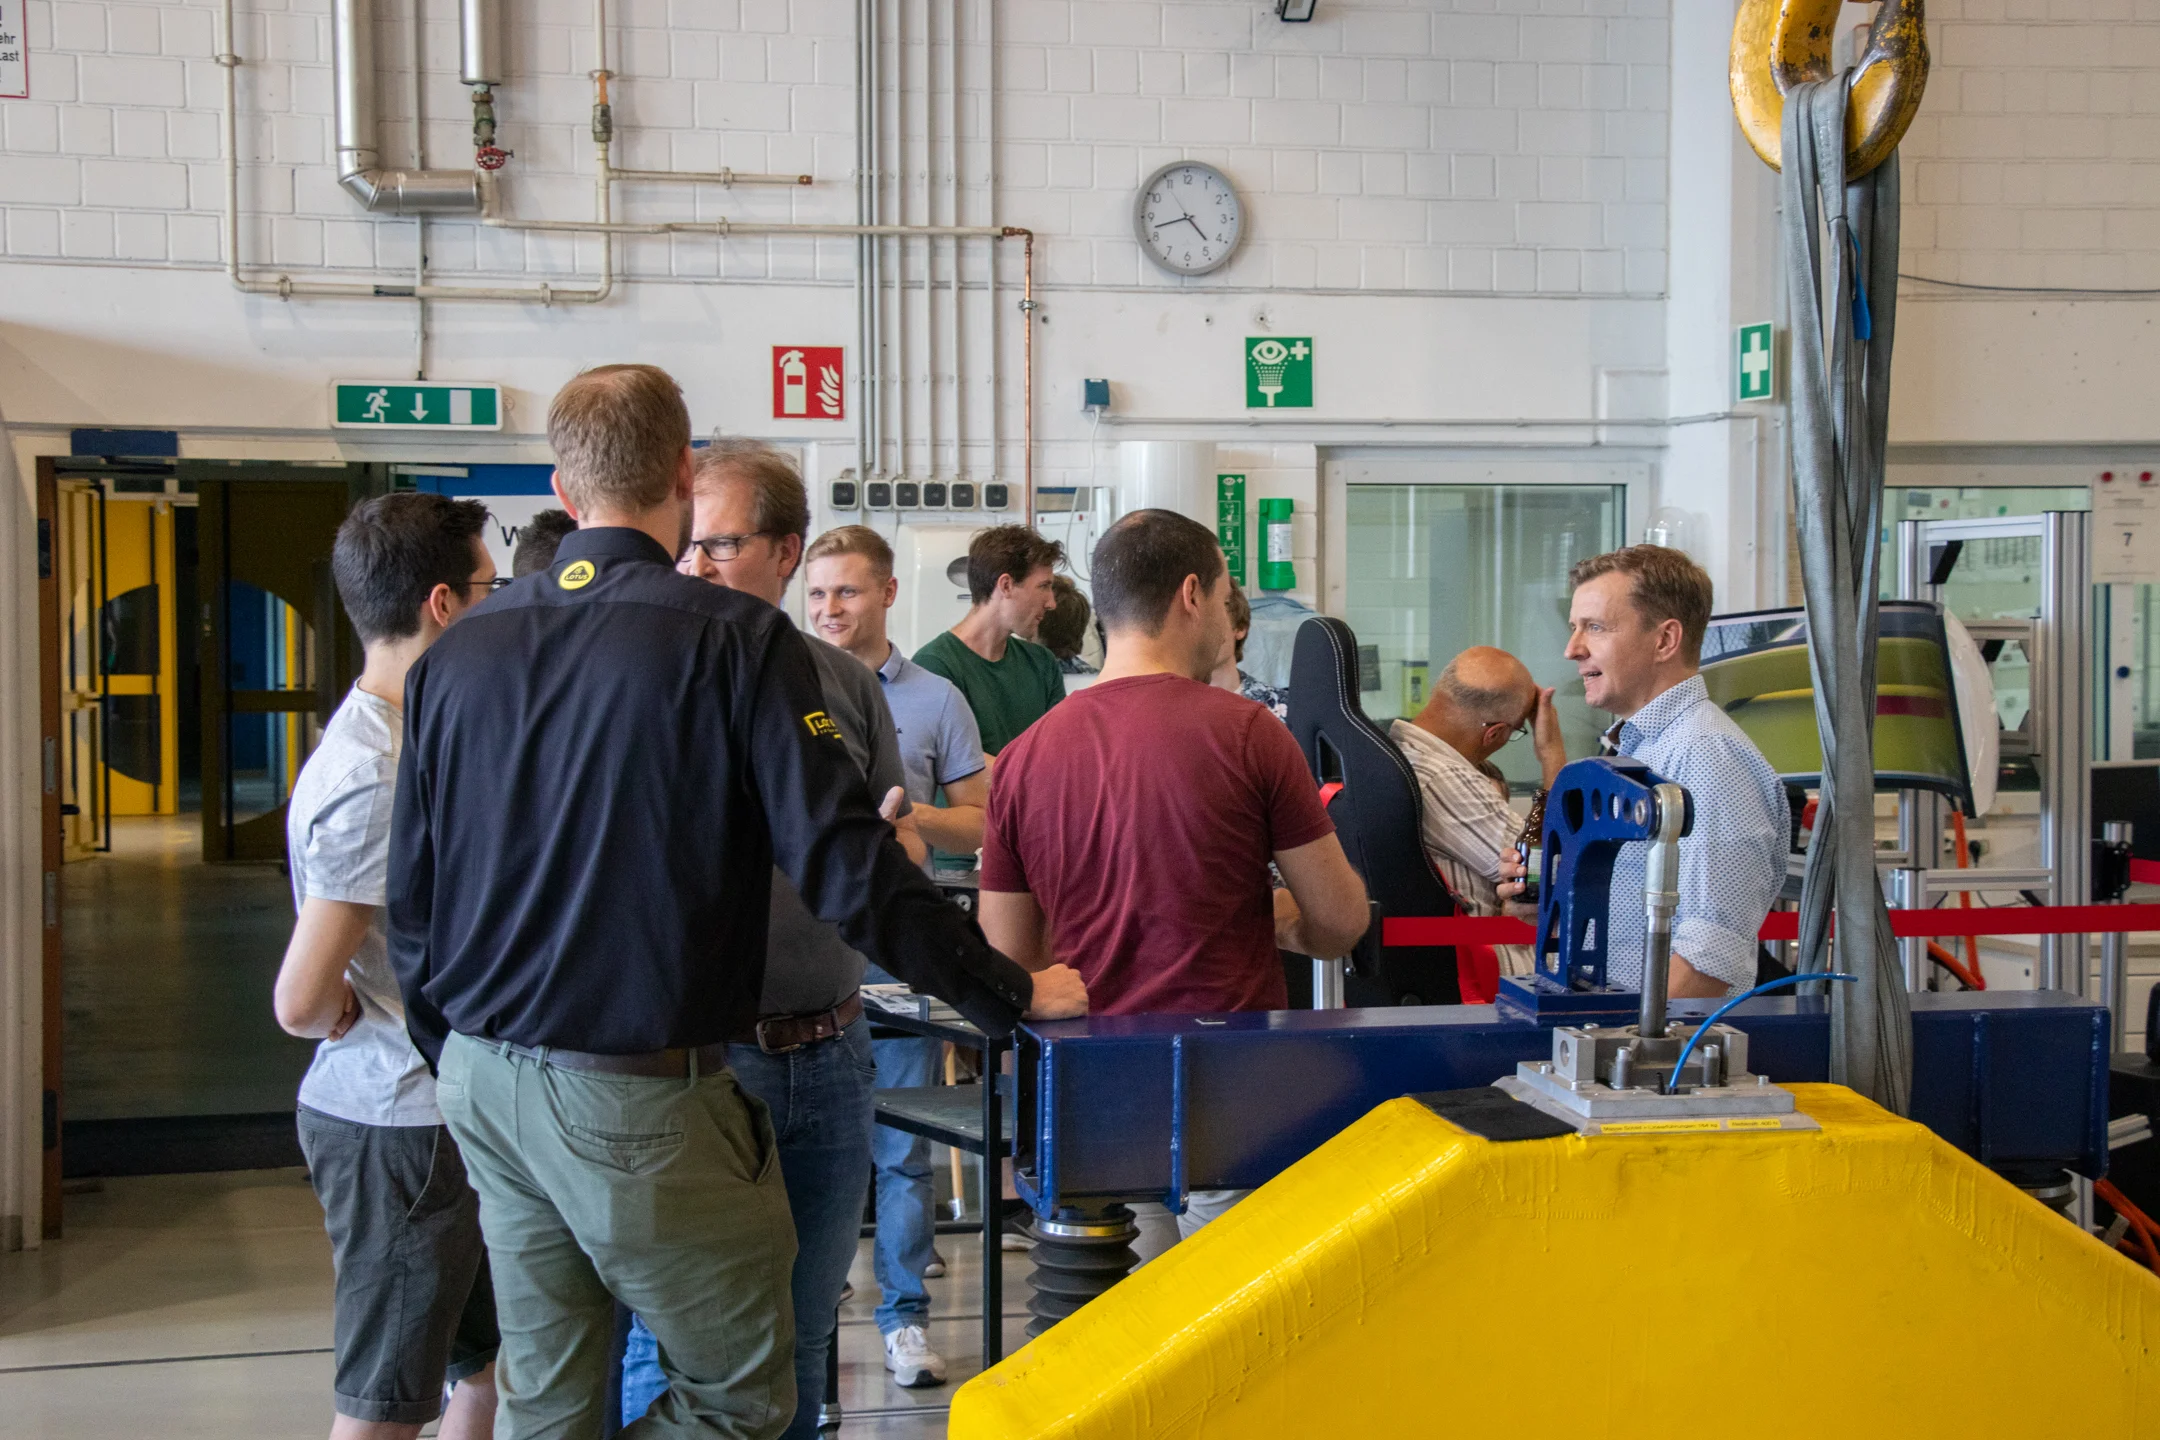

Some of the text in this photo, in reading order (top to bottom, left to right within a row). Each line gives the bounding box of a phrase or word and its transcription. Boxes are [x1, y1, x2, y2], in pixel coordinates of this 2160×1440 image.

[0, 50, 19, 62] ast
[1166, 179, 1174, 189] 11
[1183, 175, 1193, 185] 12
[1204, 180, 1208, 190] 1
[1151, 193, 1162, 203] 10
[1215, 194, 1222, 205] 2
[1147, 212, 1155, 222] 9
[1220, 213, 1227, 224] 3
[1152, 232, 1160, 241] 8
[1215, 233, 1223, 242] 4
[1166, 246, 1173, 256] 7
[1184, 251, 1191, 261] 6
[1202, 246, 1209, 257] 5
[2123, 532, 2133, 547] 7
